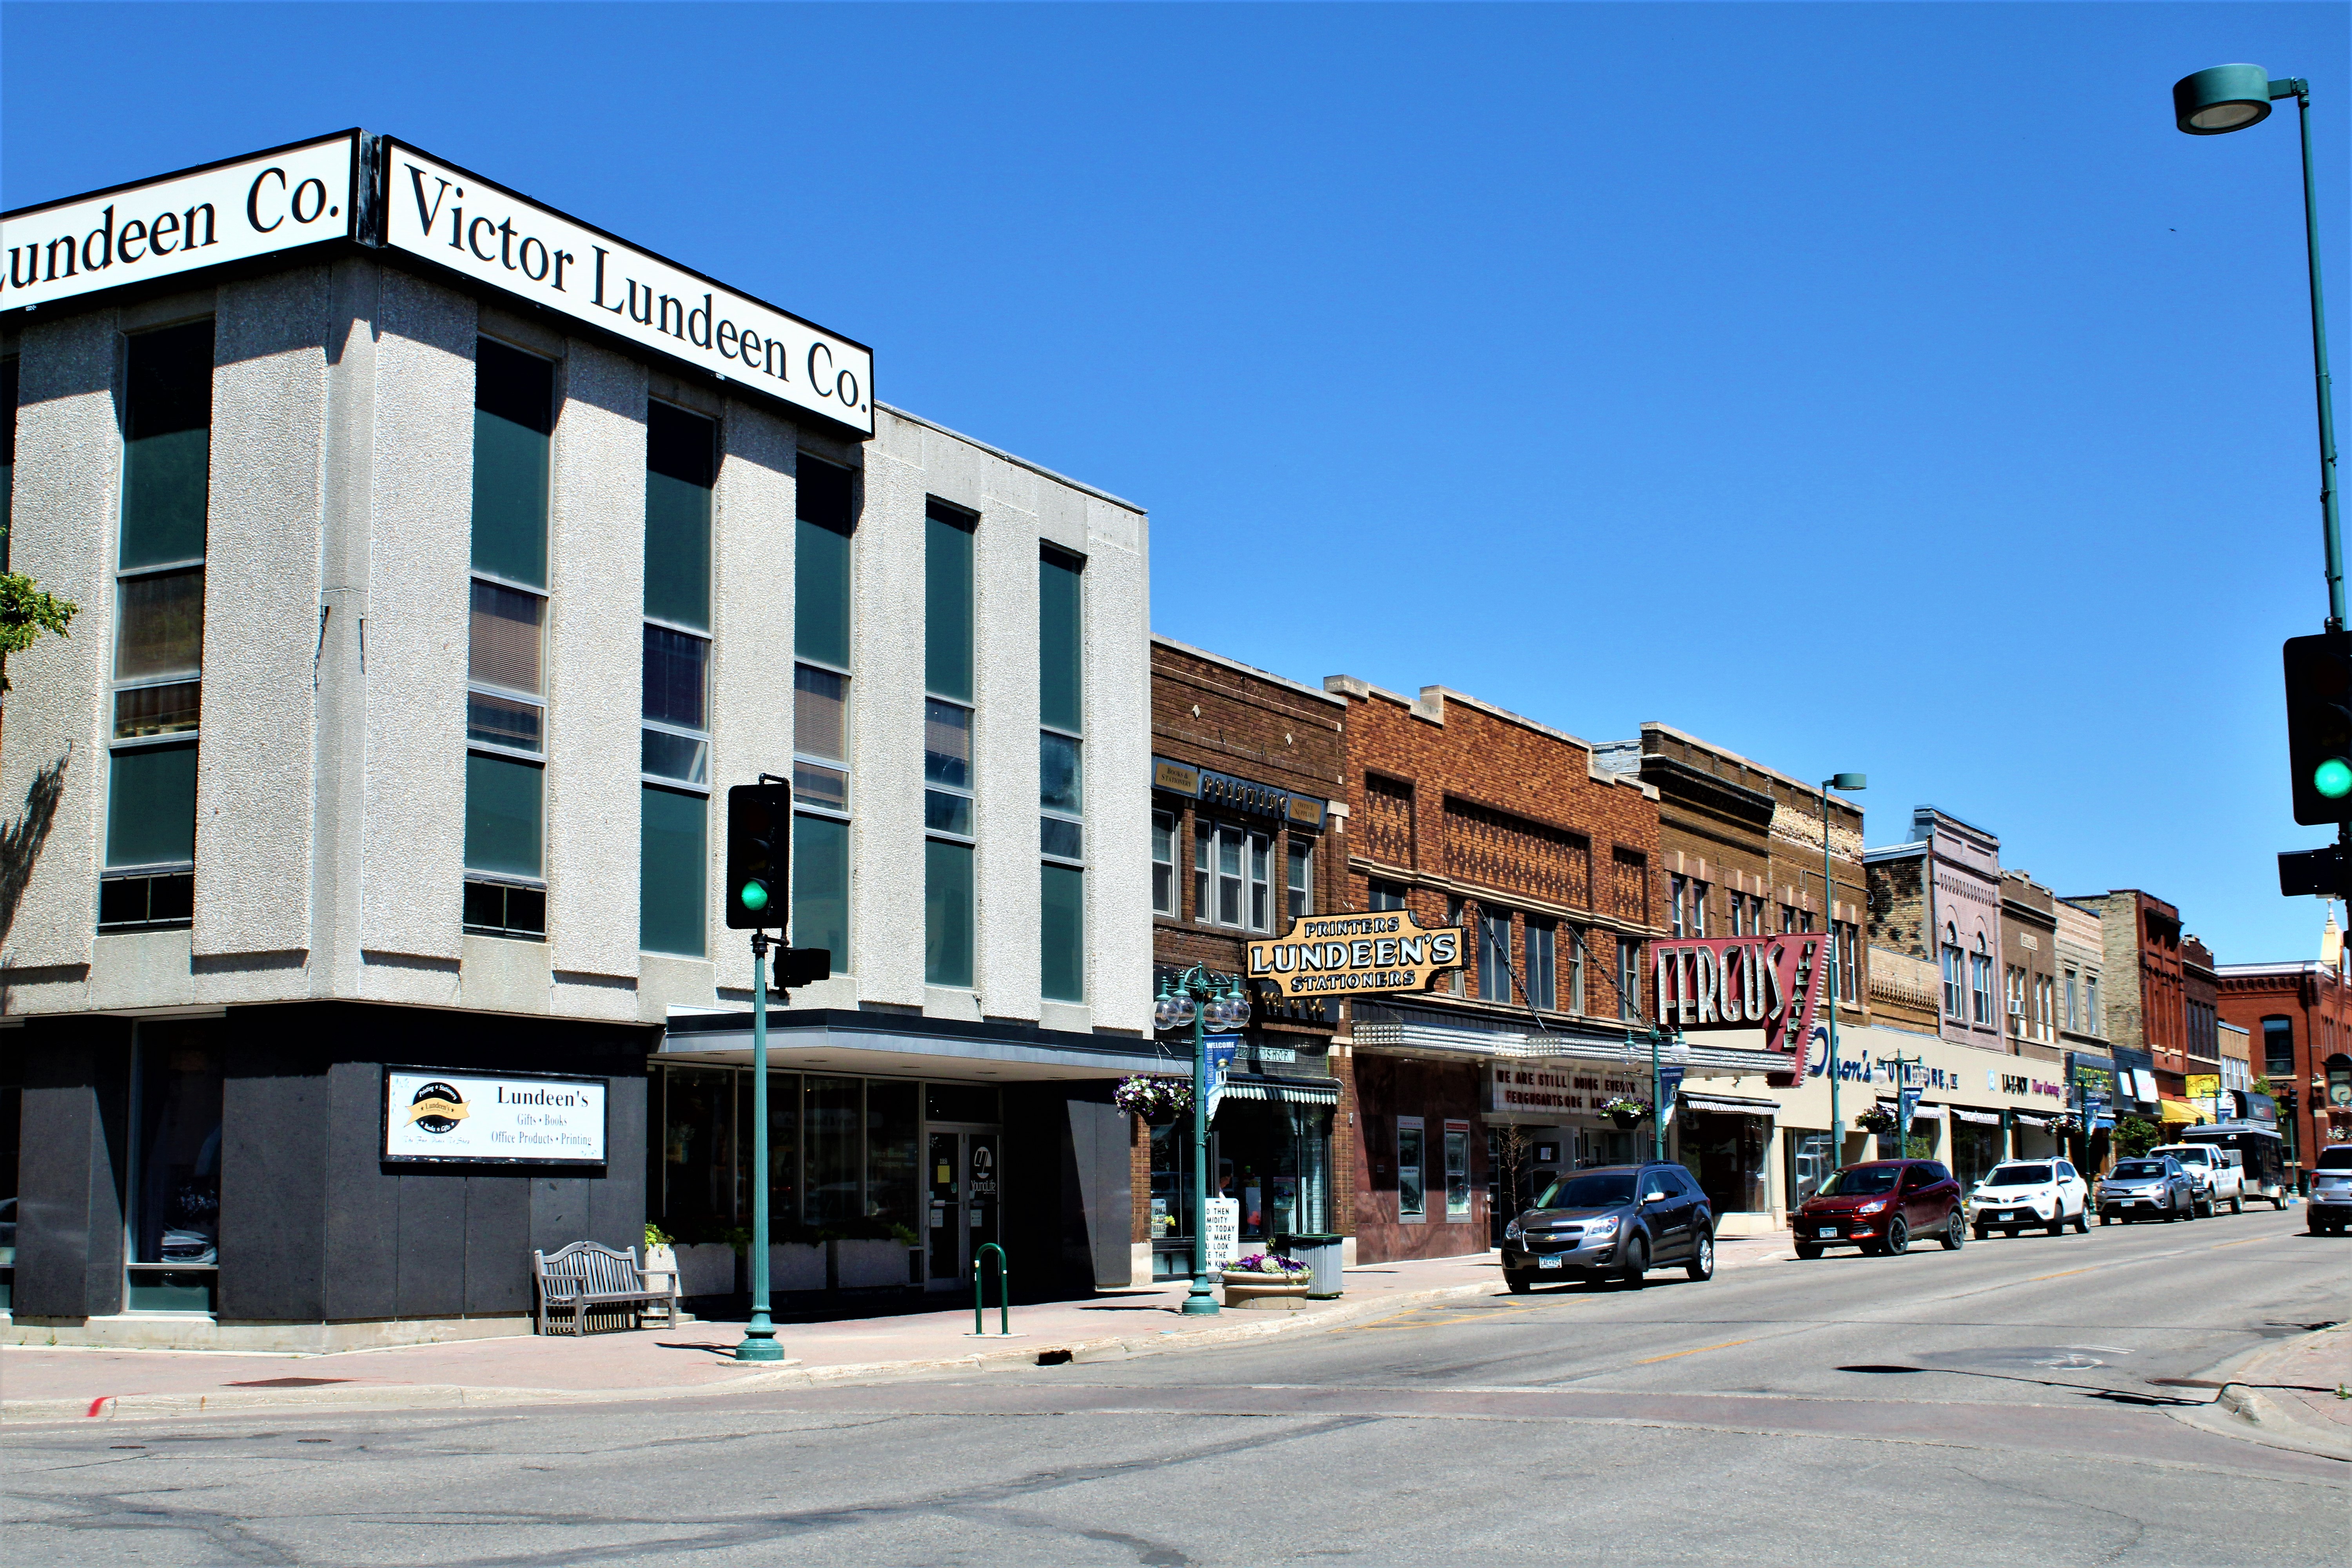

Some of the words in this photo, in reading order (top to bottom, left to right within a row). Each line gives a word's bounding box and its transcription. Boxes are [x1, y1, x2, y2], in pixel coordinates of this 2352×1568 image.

[0, 205, 218, 292] undeen
[247, 167, 339, 233] Co.
[403, 162, 574, 292] Victor
[591, 245, 789, 383] Lundeen
[807, 341, 868, 414] Co.
[1161, 774, 1191, 787] STATIONERY
[1167, 768, 1183, 777] BOOKS
[1204, 776, 1287, 812] PRINTING
[1298, 802, 1313, 811] OFFICE
[1305, 917, 1399, 938] PRINTERS
[1251, 933, 1457, 975] LUNDEEN'S
[1290, 970, 1415, 992] STATIONERS
[1658, 943, 1784, 1025] FERGUS
[1784, 940, 1816, 1048] THEATRE
[1496, 1070, 1510, 1083] WE
[1516, 1071, 1534, 1085] ARE
[1539, 1074, 1567, 1088] STILL
[1575, 1077, 1598, 1091] DOING
[419, 1085, 434, 1098] Printing
[497, 1086, 589, 1107] Lundeen's
[425, 1102, 450, 1111] Lundeen's
[424, 1123, 436, 1132] Books
[440, 1124, 451, 1132] Gifts
[517, 1113, 537, 1125] Gifts
[544, 1114, 568, 1126] Books
[492, 1131, 515, 1143] Office
[519, 1131, 554, 1144] Products
[561, 1133, 592, 1146] Printing
